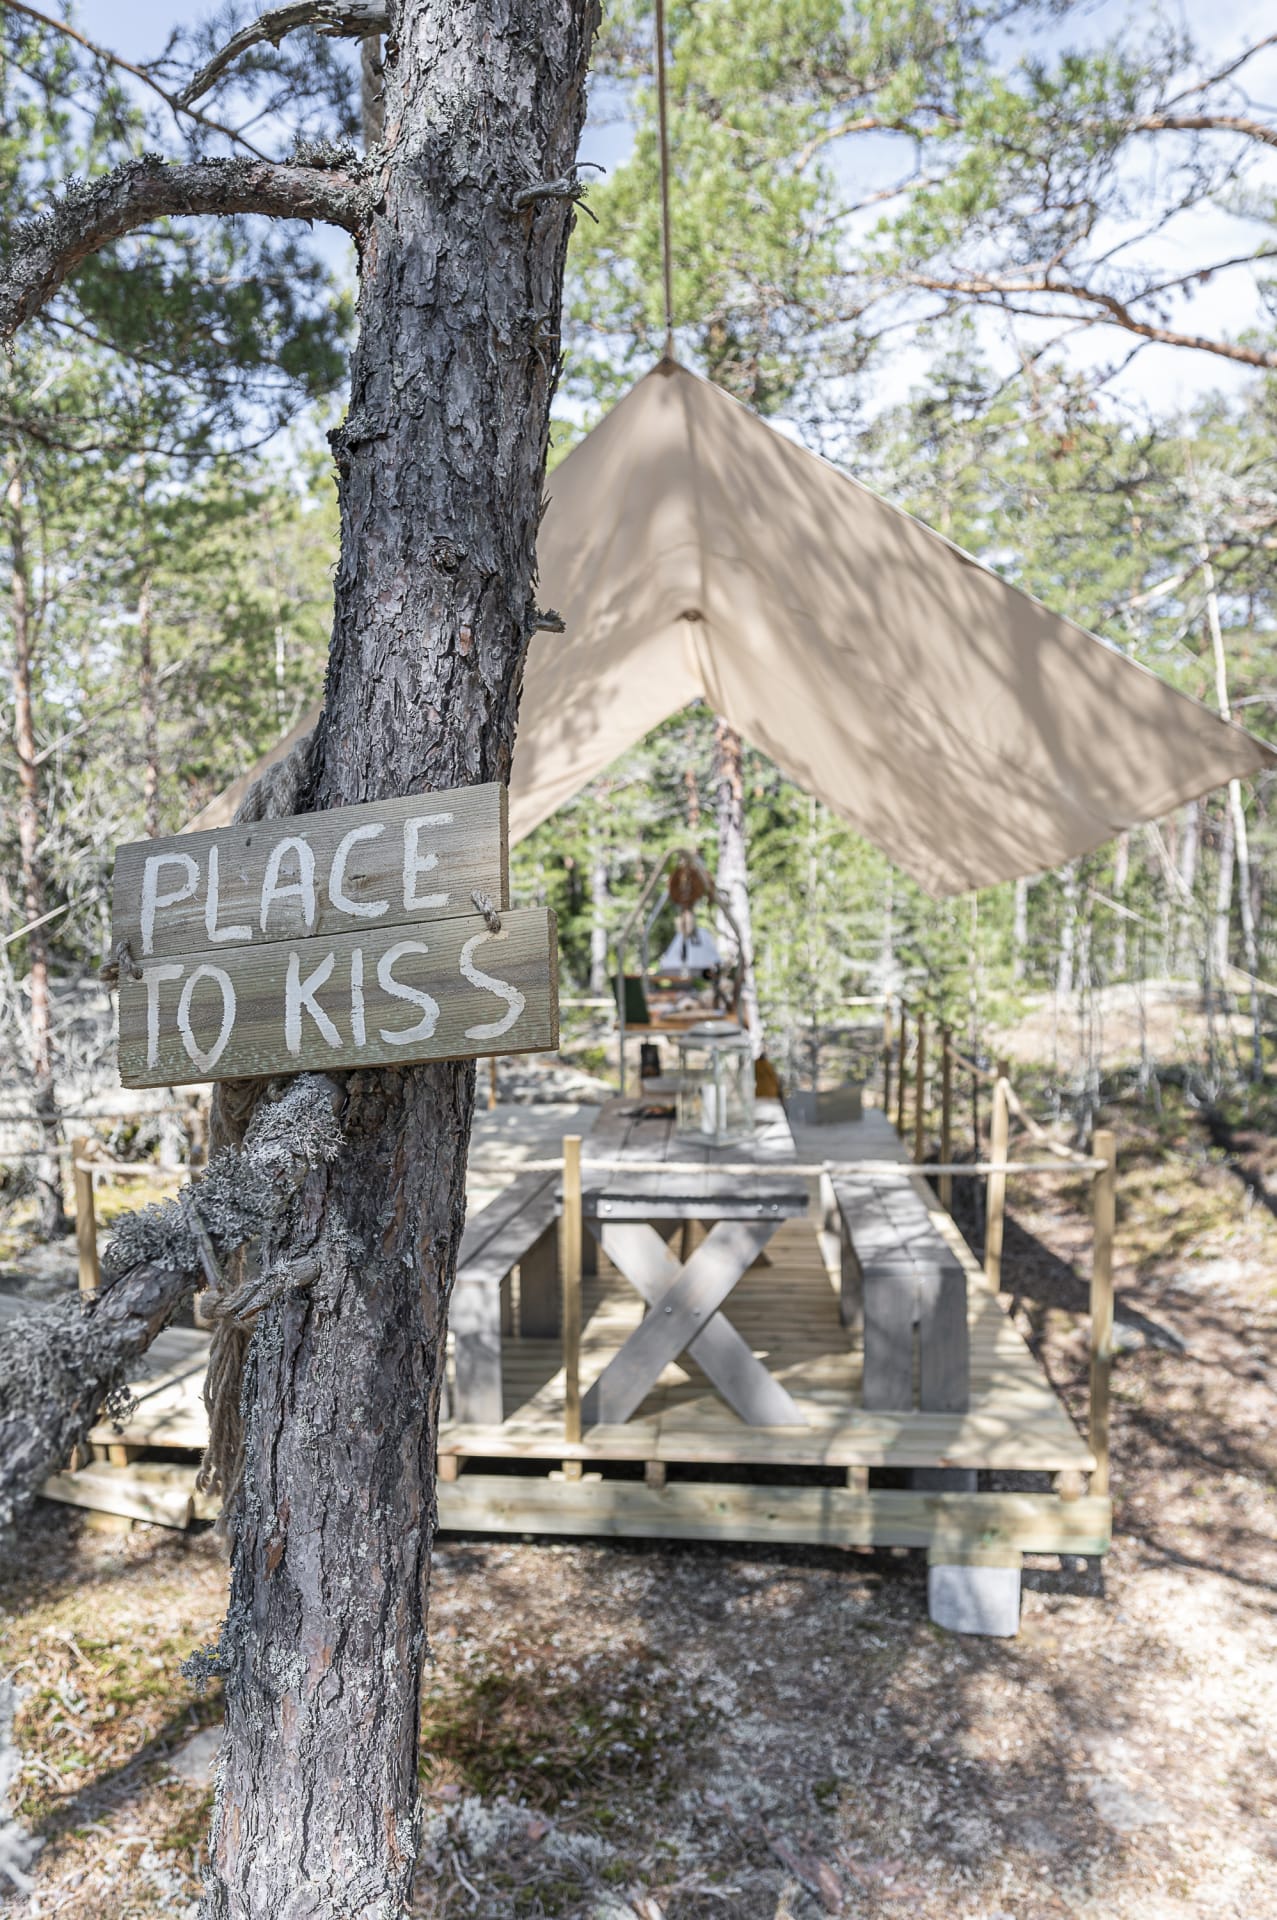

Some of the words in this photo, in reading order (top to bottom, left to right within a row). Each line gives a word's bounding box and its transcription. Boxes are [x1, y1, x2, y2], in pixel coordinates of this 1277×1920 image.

[141, 813, 454, 955] PLACE
[141, 964, 236, 1073] TO
[285, 930, 525, 1055] KISS
